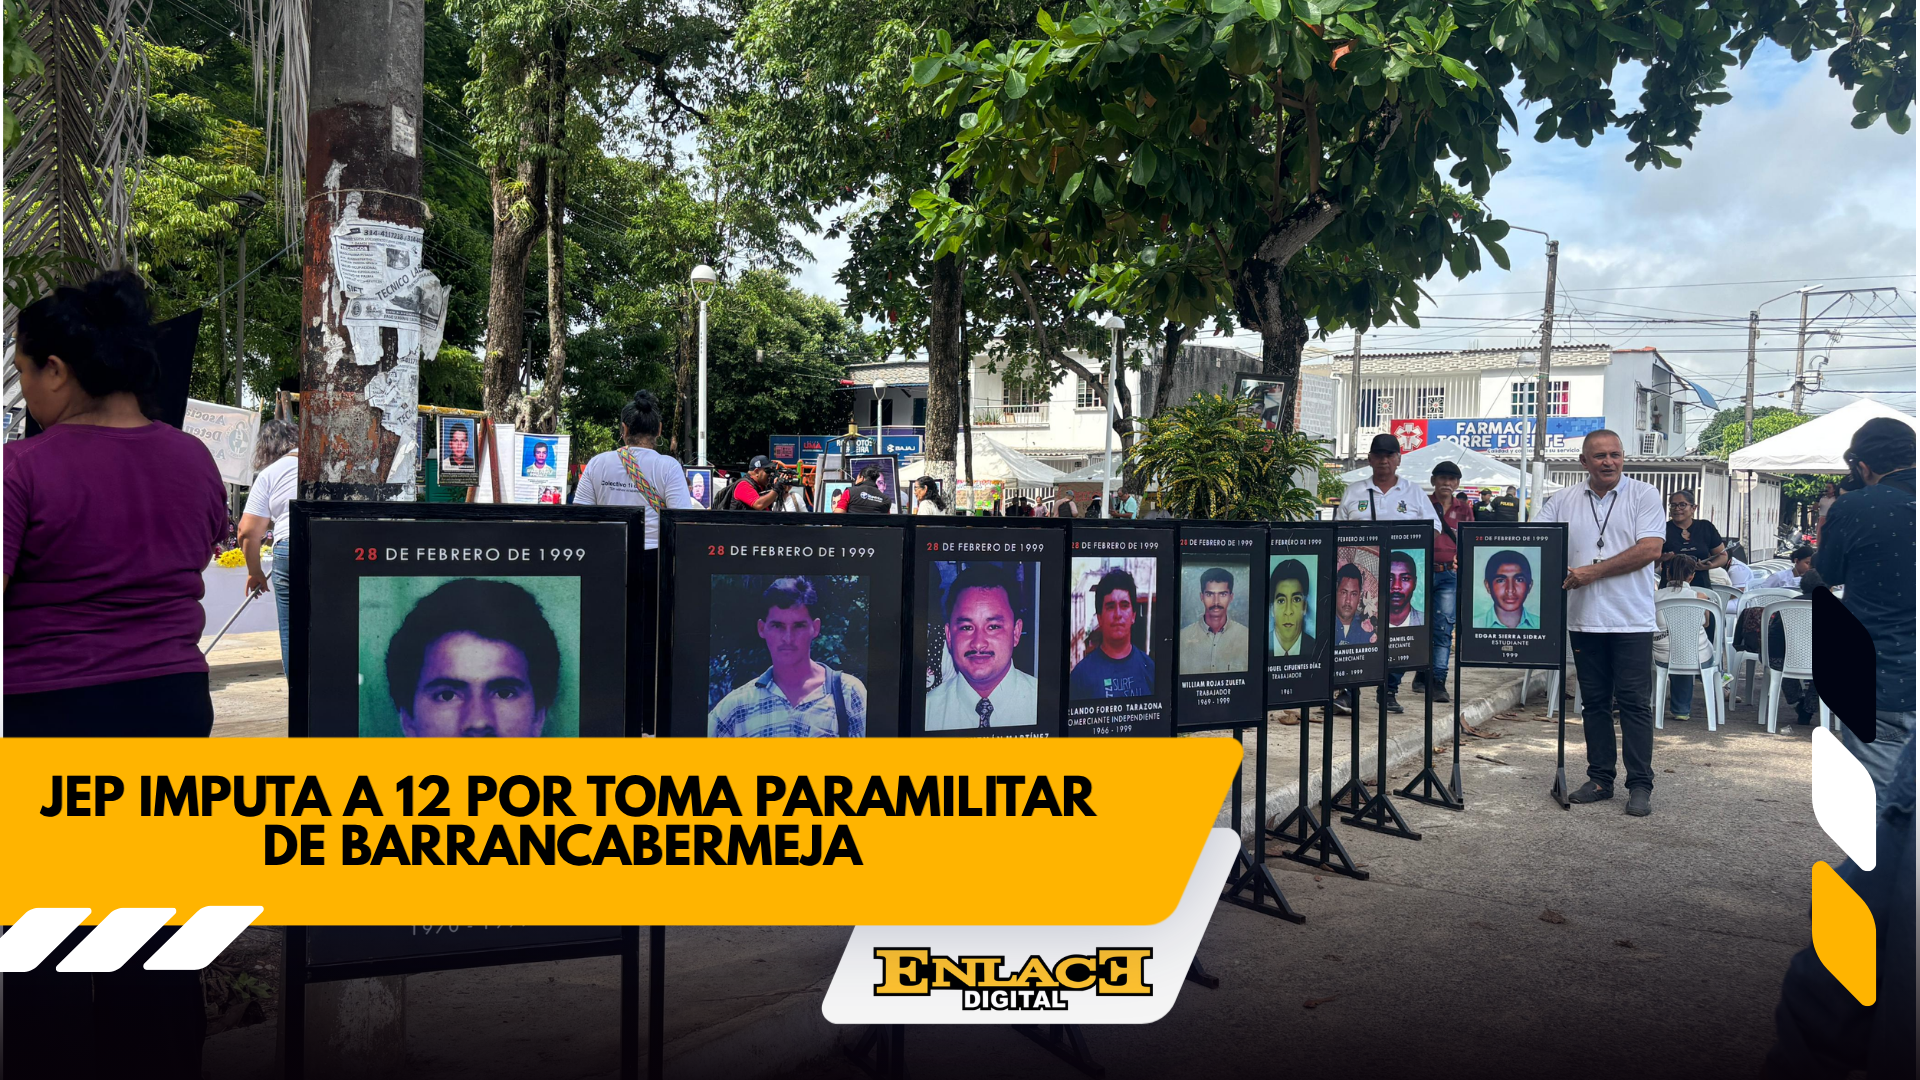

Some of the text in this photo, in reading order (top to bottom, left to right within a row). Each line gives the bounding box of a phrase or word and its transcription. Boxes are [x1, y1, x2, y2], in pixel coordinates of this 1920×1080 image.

[375, 274, 410, 300] TECNICO
[1456, 421, 1537, 434] FARMACIA
[1437, 434, 1492, 448] TORRE
[708, 546, 875, 558] 28 DE FEBRERO DE 1999
[927, 542, 1044, 552] 28 DE FEBRERO DE 1999
[355, 548, 586, 561] 28 DE FEBRERO DE 1999
[1113, 677, 1134, 690] SURF
[1096, 705, 1122, 713] FORERO
[1126, 702, 1162, 711] TARAZONA
[1112, 712, 1160, 723] INDEPENDIENTE
